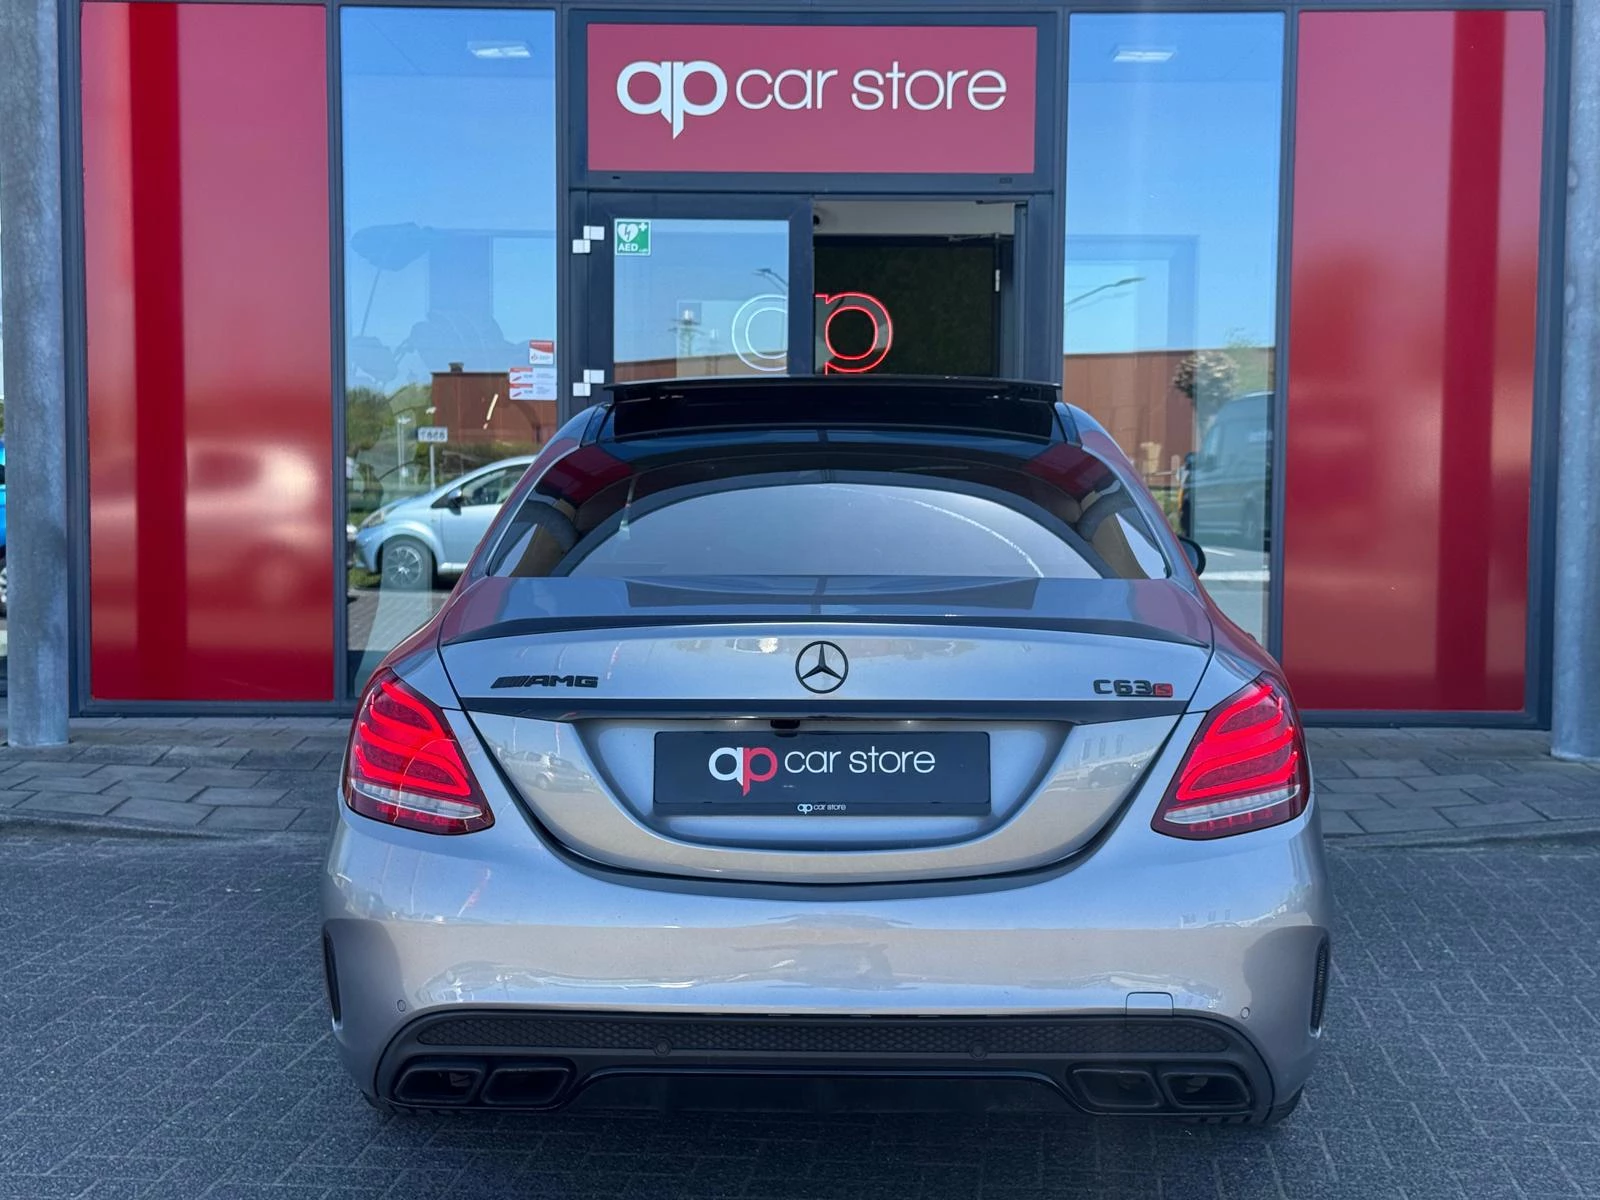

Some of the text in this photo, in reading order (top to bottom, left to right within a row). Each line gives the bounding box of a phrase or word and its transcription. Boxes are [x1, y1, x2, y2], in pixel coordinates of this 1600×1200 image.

[616, 60, 1007, 139] ap car store
[618, 243, 639, 252] AED
[522, 675, 599, 689] AMG
[708, 745, 936, 796] ap car store
[797, 803, 813, 815] ap
